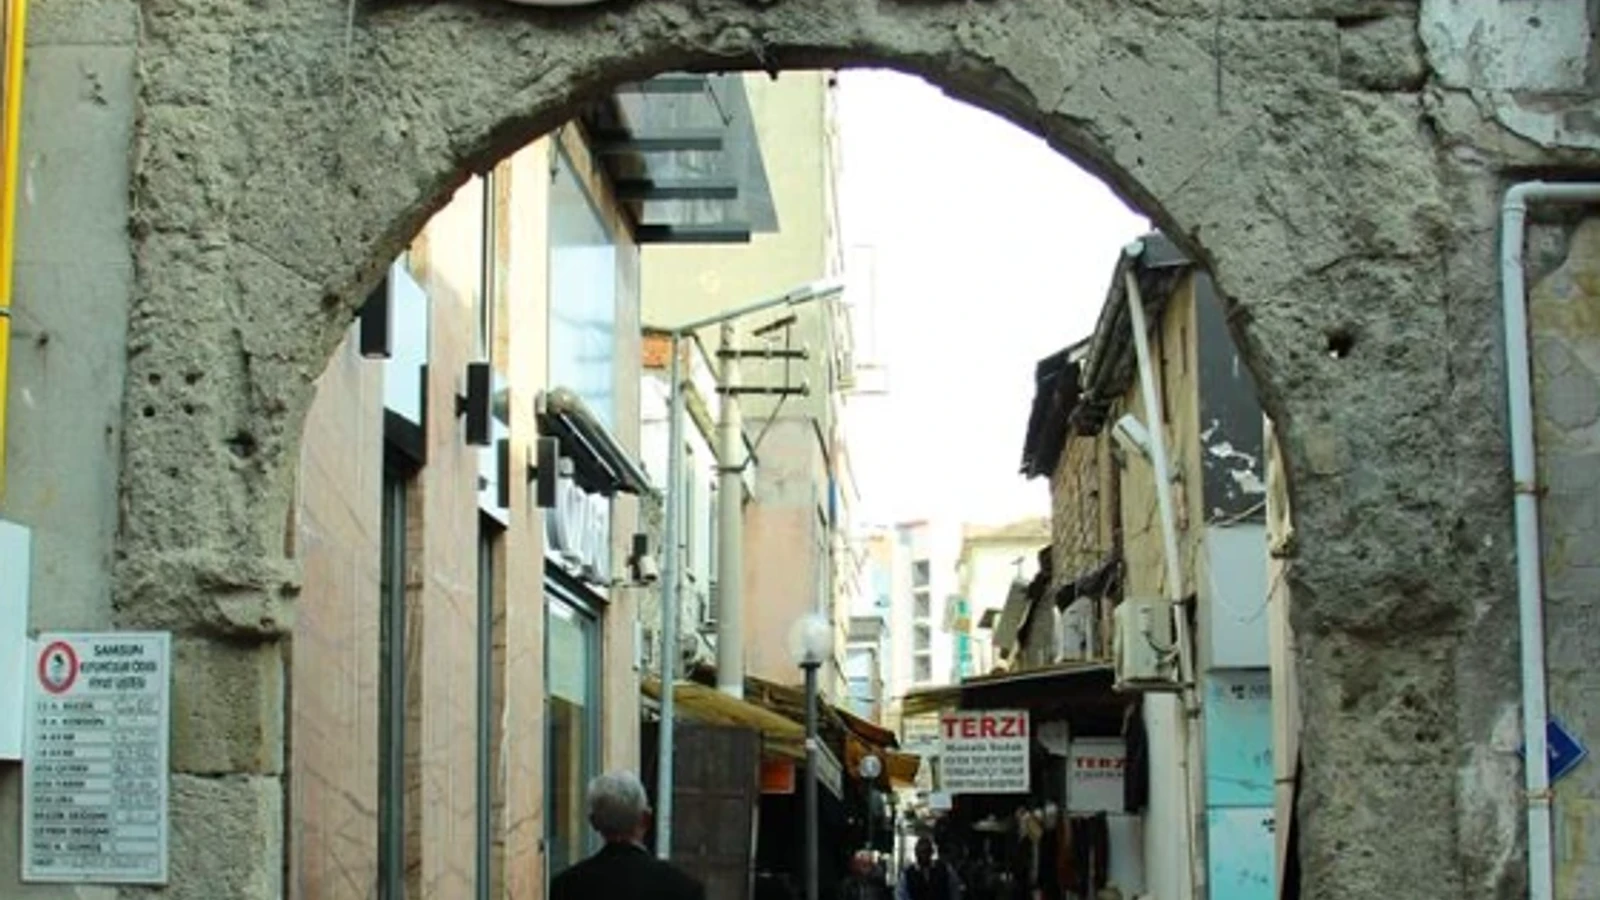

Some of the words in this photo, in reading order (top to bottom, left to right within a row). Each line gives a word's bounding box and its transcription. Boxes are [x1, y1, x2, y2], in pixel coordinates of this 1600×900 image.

[94, 644, 144, 656] SAMSUN
[941, 713, 1026, 738] TERZİ
[1076, 757, 1114, 769] TERZ
